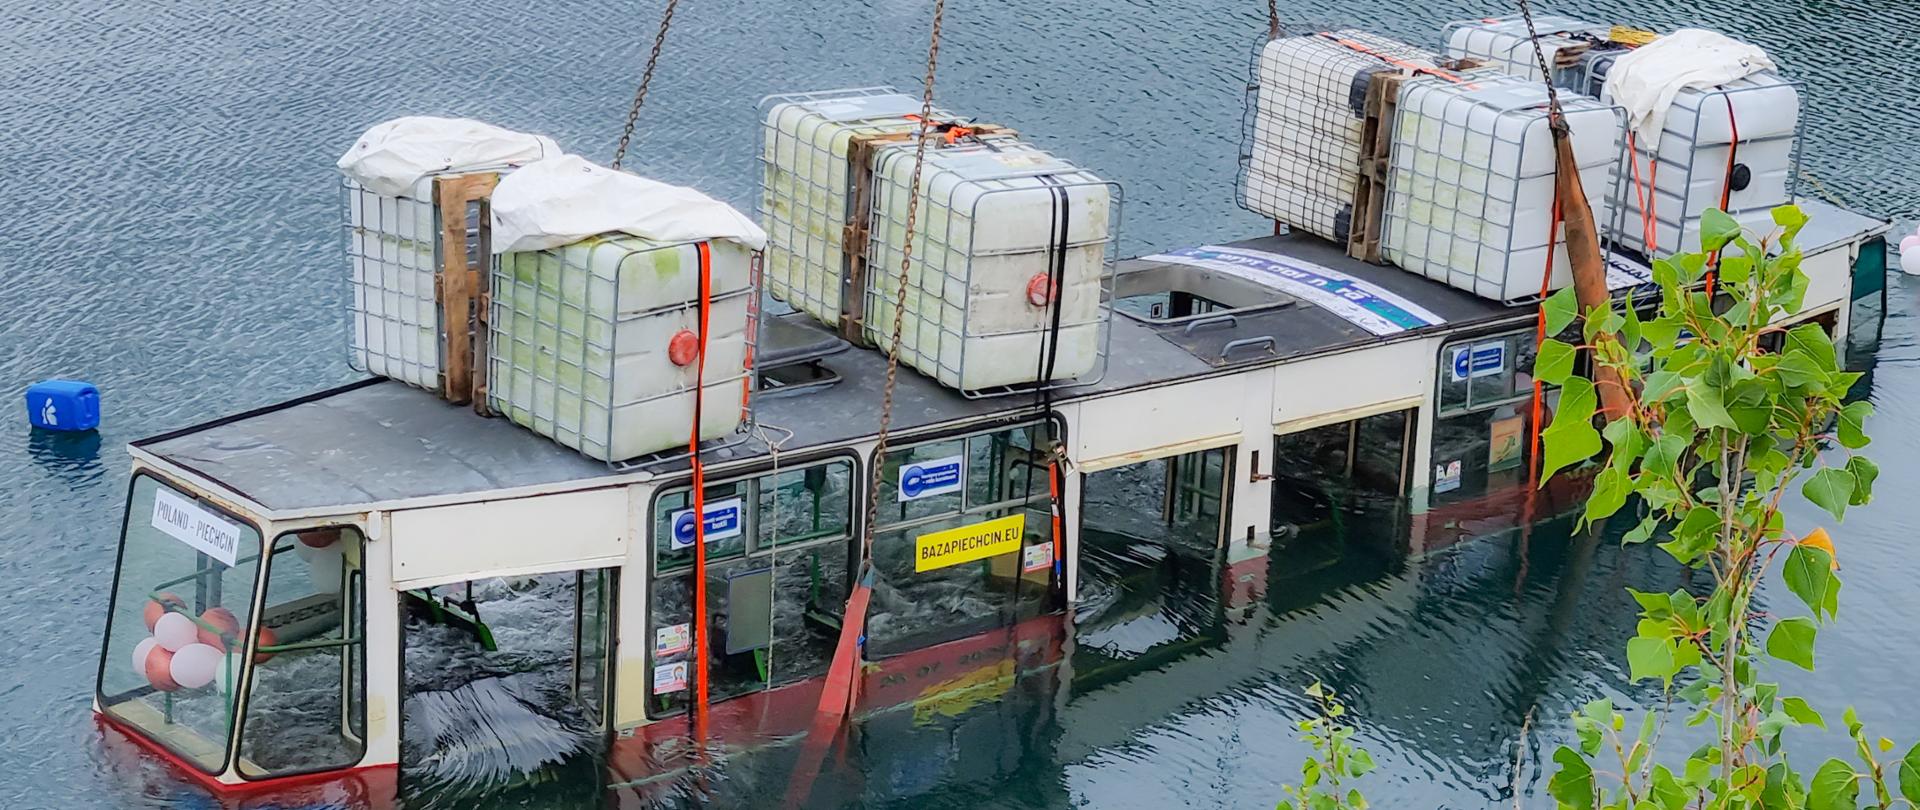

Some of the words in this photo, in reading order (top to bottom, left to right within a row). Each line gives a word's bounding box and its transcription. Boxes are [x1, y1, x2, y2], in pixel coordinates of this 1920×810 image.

[157, 500, 189, 530] POLAND
[196, 520, 235, 554] PIECHCIN
[921, 526, 1020, 561] BAZAPIECHCIN.EU
